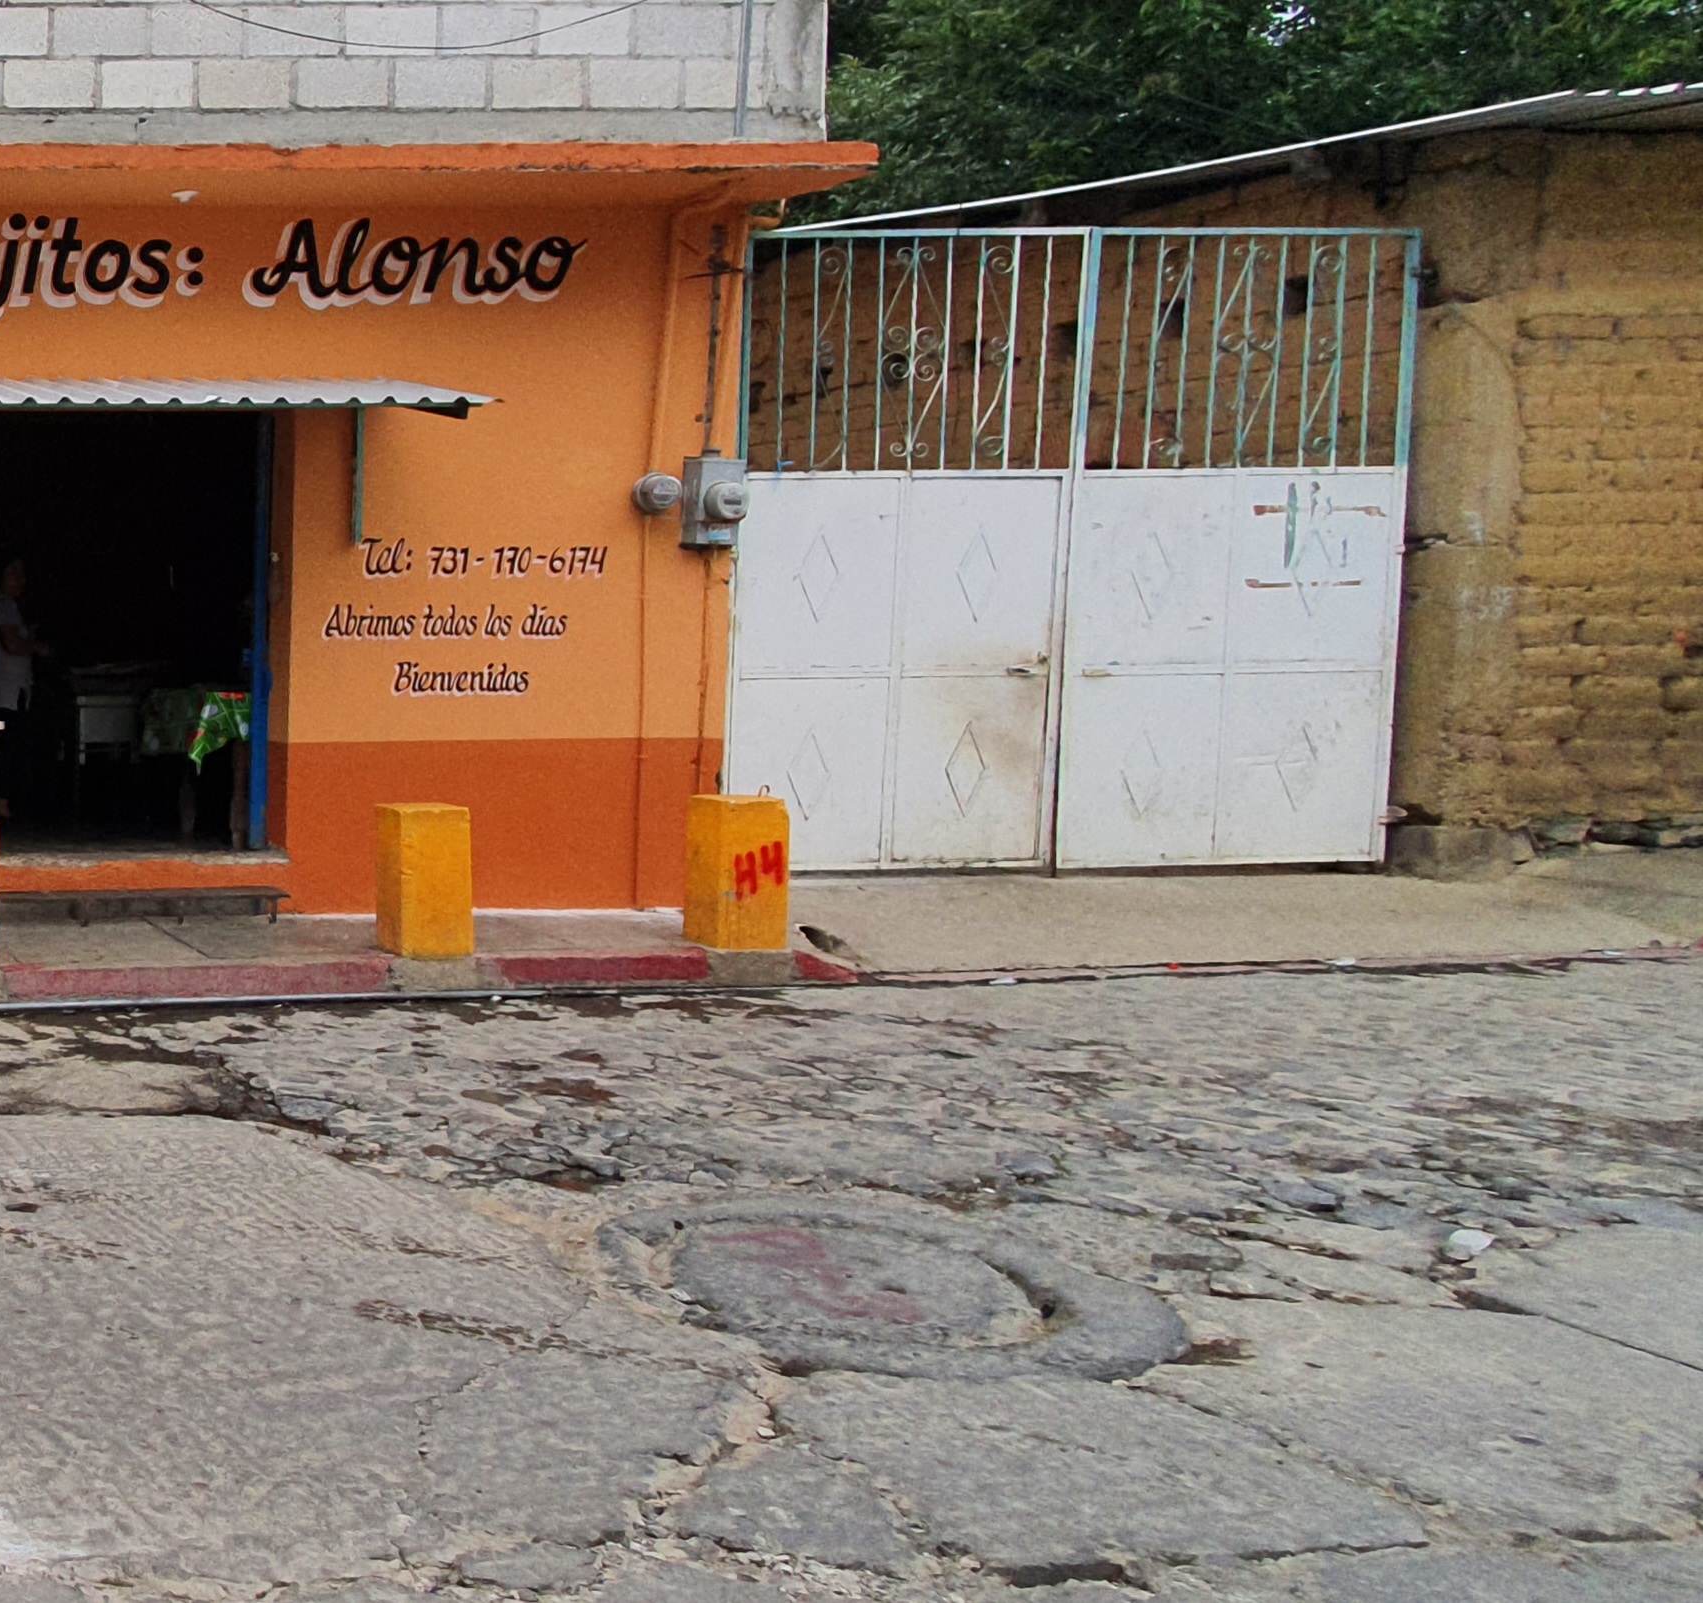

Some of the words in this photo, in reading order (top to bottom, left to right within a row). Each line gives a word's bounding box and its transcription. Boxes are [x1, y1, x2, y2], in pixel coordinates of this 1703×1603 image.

[251, 217, 586, 300] Alonso
[361, 537, 413, 576] Tel:
[324, 603, 416, 638] Abrimos
[423, 603, 477, 638] todos
[484, 603, 512, 638] los
[393, 661, 529, 693] Bienvenidos
[734, 840, 785, 901] H4
